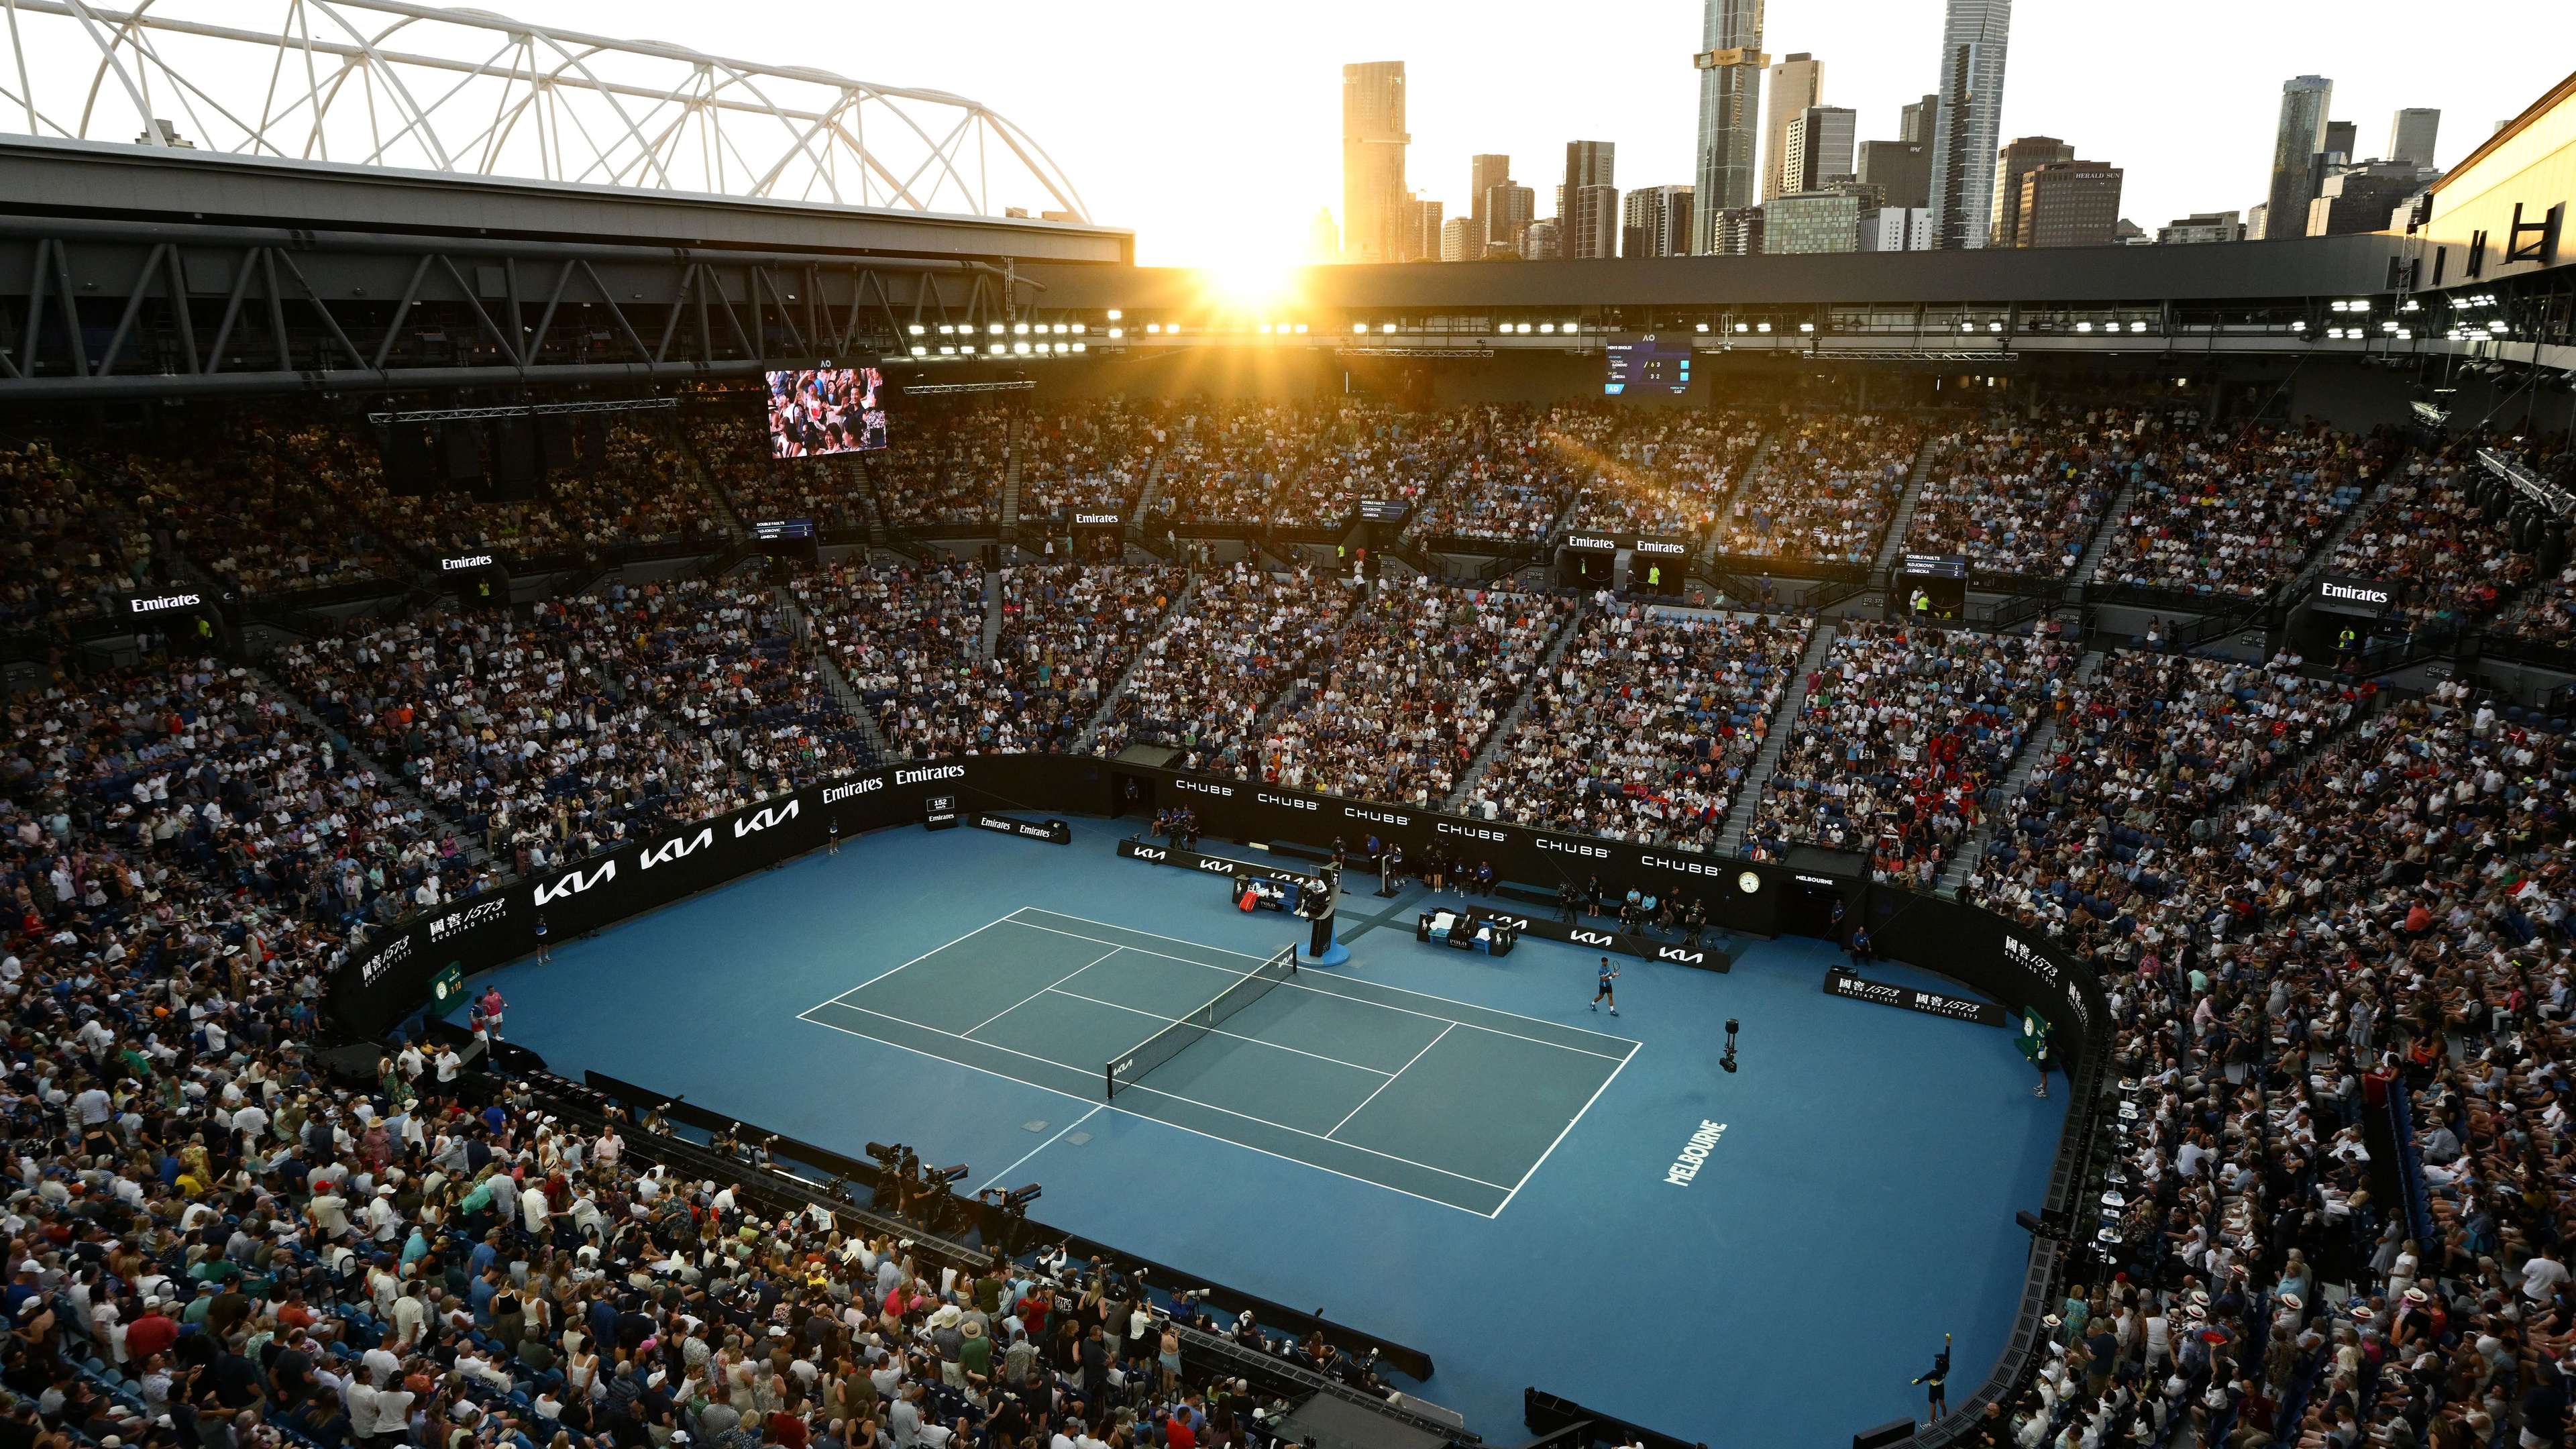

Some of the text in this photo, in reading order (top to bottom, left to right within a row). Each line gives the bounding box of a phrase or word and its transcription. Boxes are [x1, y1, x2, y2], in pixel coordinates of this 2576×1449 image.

[1075, 514, 1118, 523] Emirates
[1569, 536, 1615, 549] Emirates
[1637, 540, 1684, 553] Emirates
[441, 555, 492, 570] Emirates
[2322, 582, 2387, 603] Emirates
[130, 594, 201, 612] Emirates
[895, 765, 965, 785] Emirates
[822, 777, 883, 804] Emirates
[1176, 780, 1232, 796] CHUBB
[1258, 793, 1317, 810] CHUBB
[734, 799, 799, 838] KIA
[928, 813, 955, 822] Emirates
[981, 817, 1011, 830] Emirates
[1344, 807, 1408, 826] CHUBB
[1019, 824, 1051, 838] Emirates
[1438, 822, 1505, 842] CHUBB
[640, 827, 713, 870] KIA
[1134, 847, 1166, 860] KIA
[1536, 839, 1608, 858] CHUBB
[1199, 859, 1234, 873] KIA
[1642, 855, 1718, 876] CHUBB
[533, 859, 616, 906] KIA
[1795, 875, 1833, 885] MELBOURNE
[431, 910, 506, 943] GUOJIAO 1573
[1450, 938, 1467, 947] POLO
[1570, 929, 1613, 947] KIA
[1658, 947, 1703, 964] KIA
[365, 949, 412, 987] GUOJIAO 1573
[2004, 950, 2056, 988] GUOJIAO 1573
[1837, 988, 1874, 999] GUOJIAO
[1915, 1003, 1978, 1020] GUOJIAO 1573
[1113, 1059, 1133, 1076] KIA
[1662, 1119, 1728, 1187] MELBOURNE
